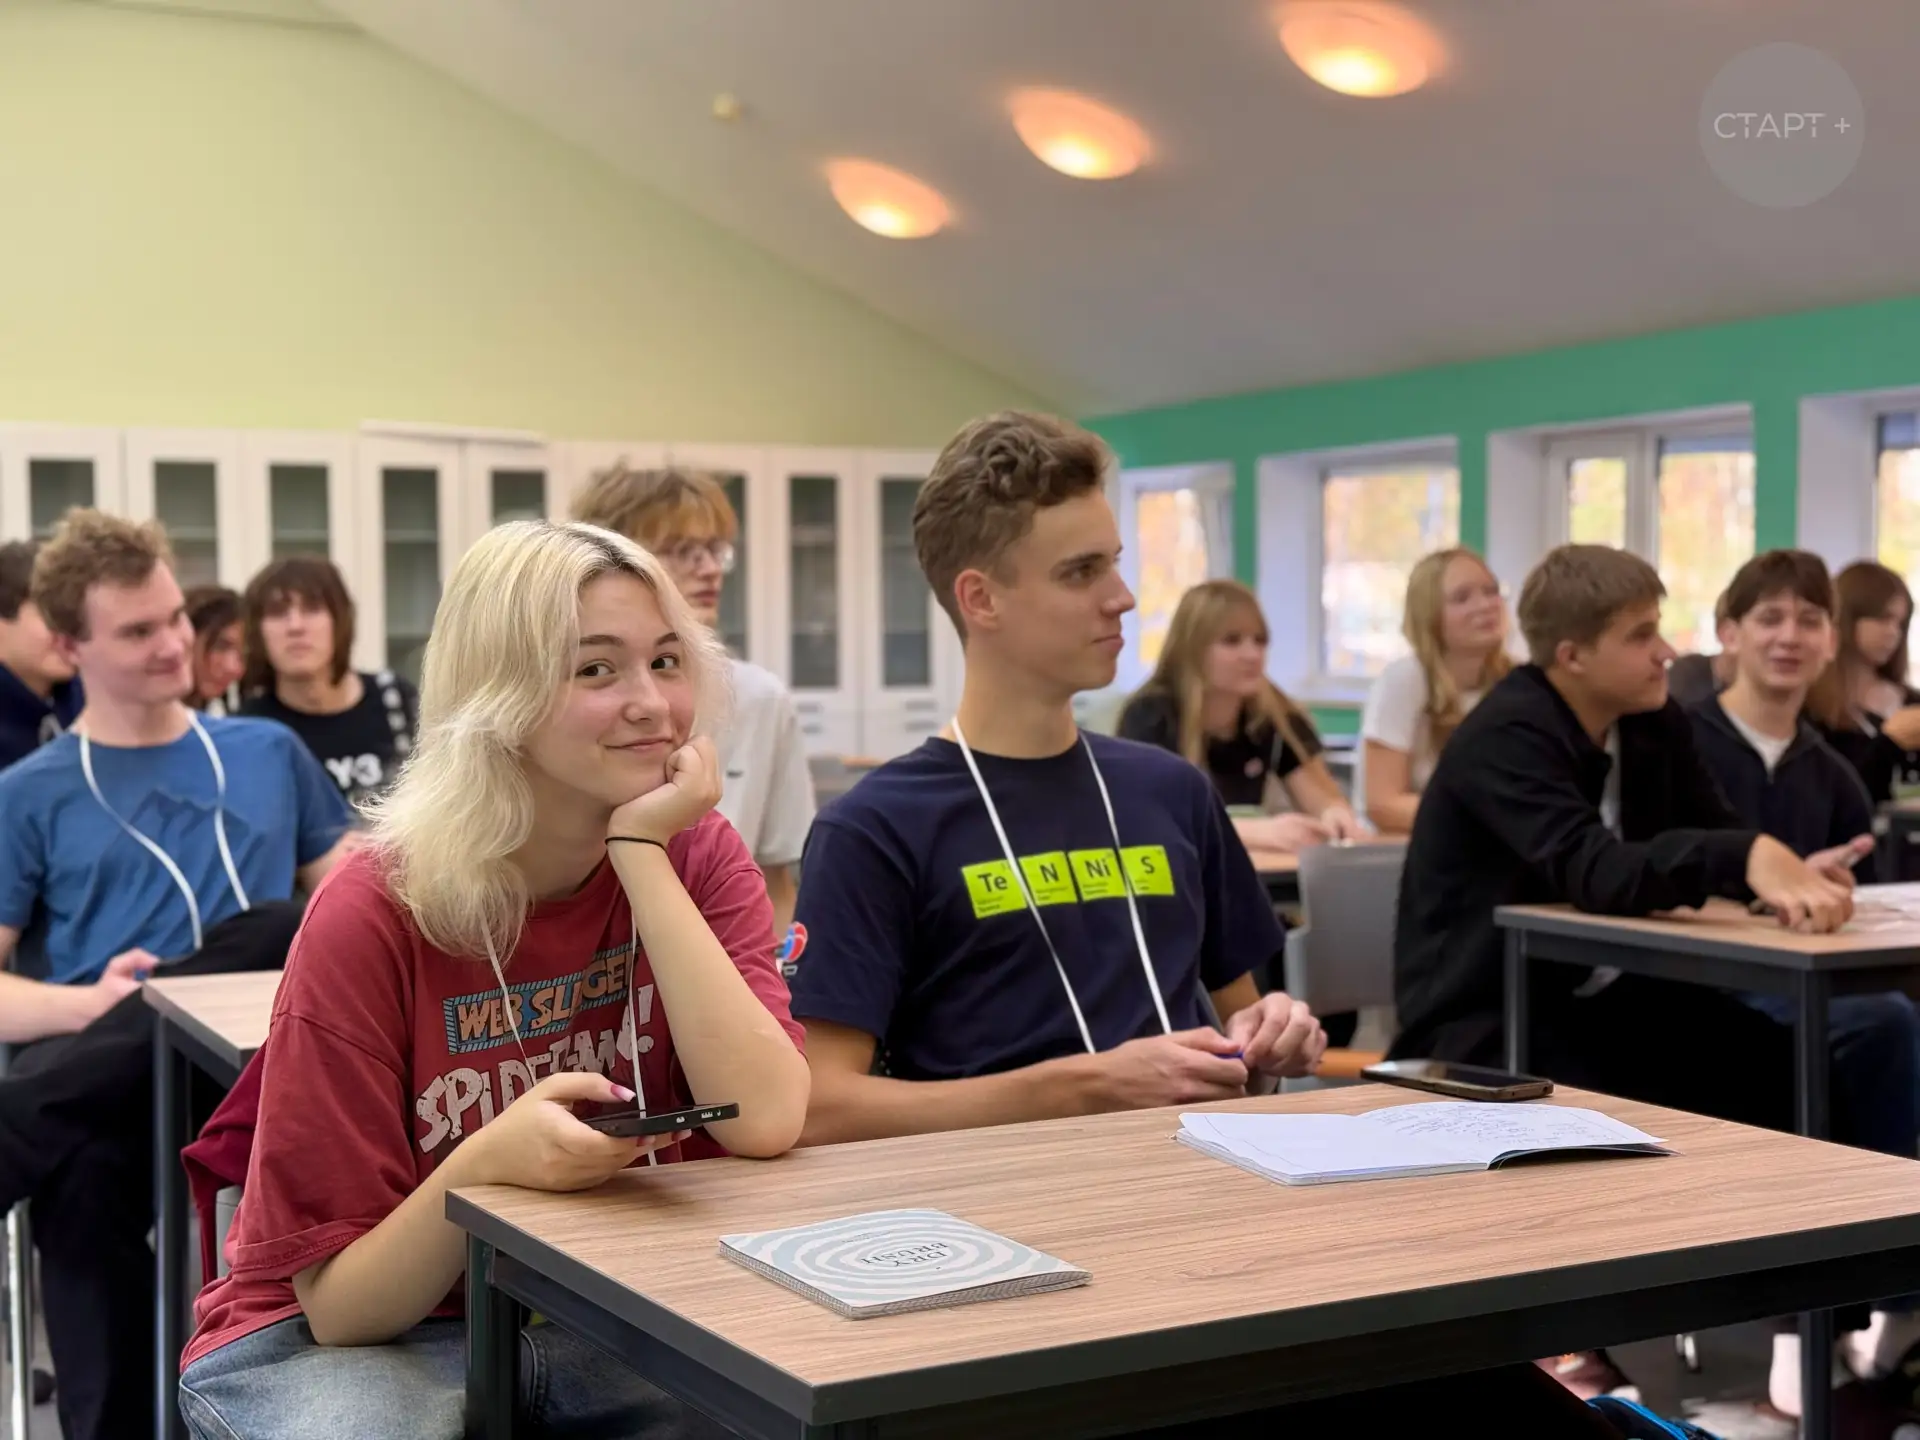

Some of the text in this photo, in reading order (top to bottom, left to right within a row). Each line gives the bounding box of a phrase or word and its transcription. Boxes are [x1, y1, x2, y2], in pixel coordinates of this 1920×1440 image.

[456, 990, 523, 1041] WEB
[860, 1242, 949, 1264] BRUSH
[893, 1251, 948, 1267] DRY
